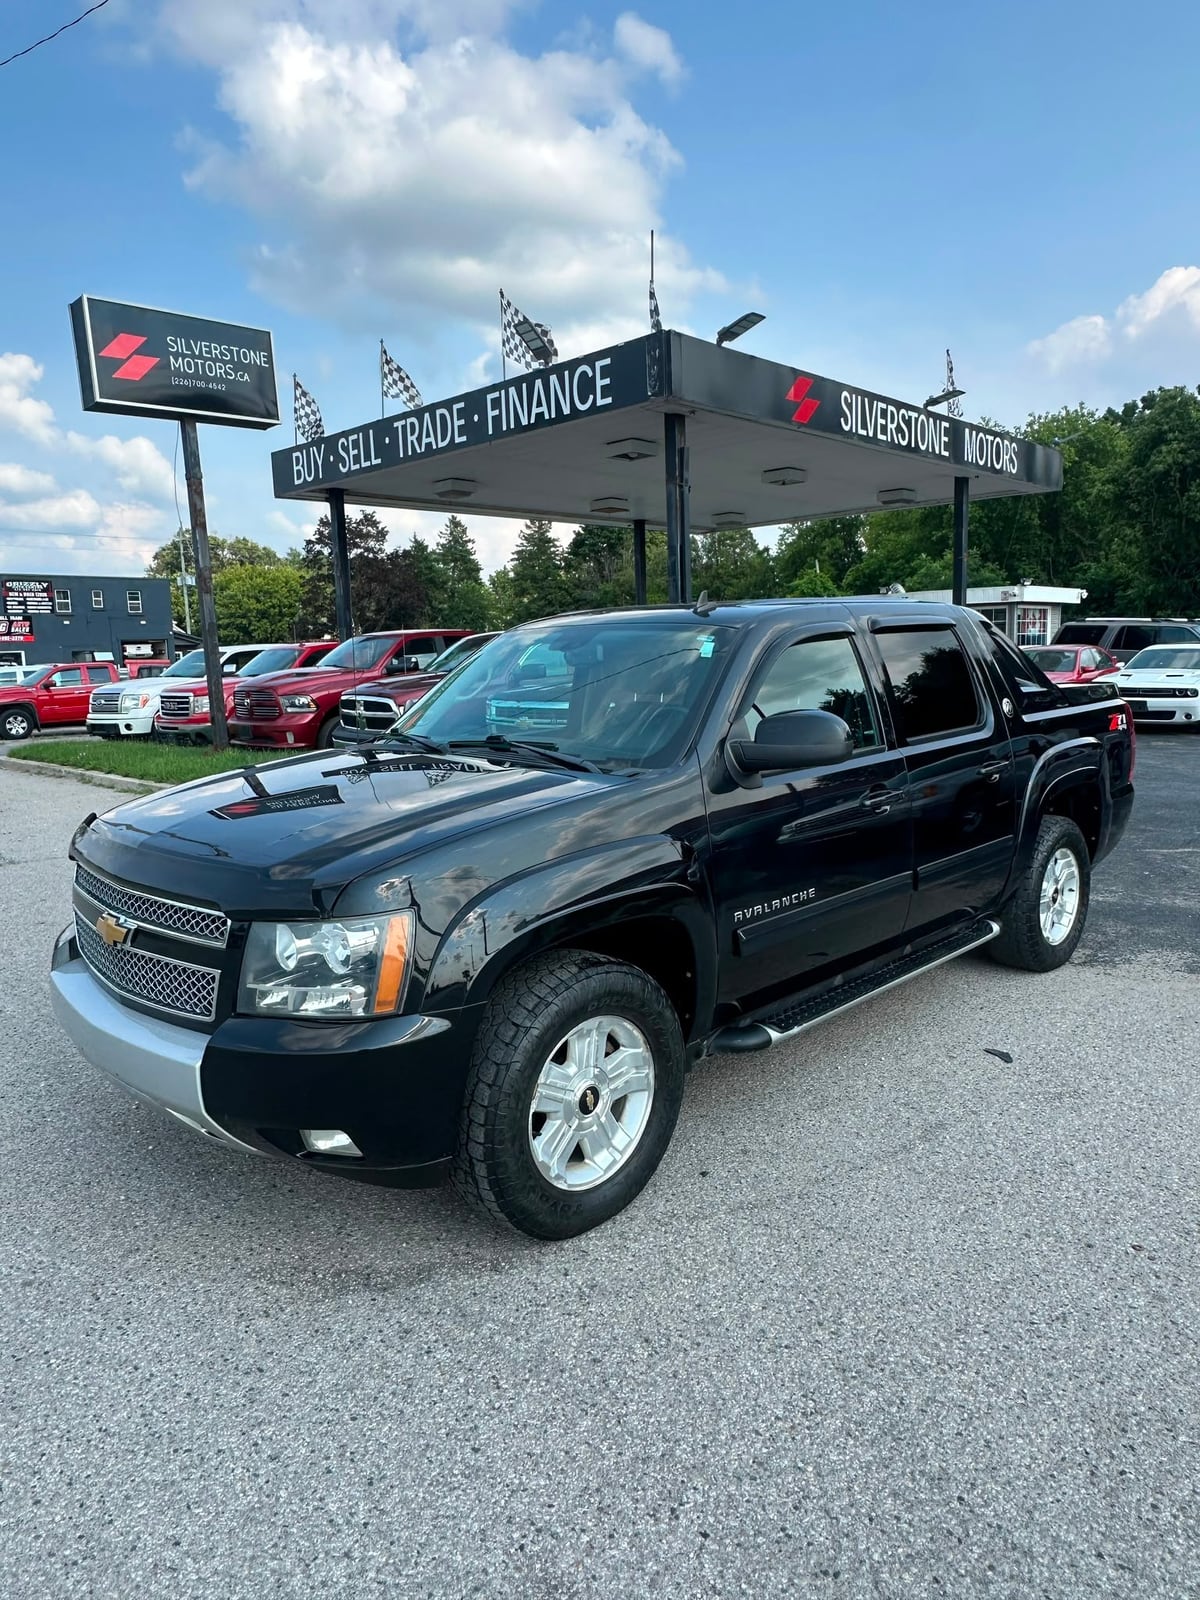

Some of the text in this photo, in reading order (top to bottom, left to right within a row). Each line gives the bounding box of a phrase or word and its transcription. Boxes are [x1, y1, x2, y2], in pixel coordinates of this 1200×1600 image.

[166, 336, 269, 367] SILVERSTONE
[169, 355, 250, 382] MOTORS.CA
[171, 376, 226, 391] (226)700-4542
[292, 357, 613, 485] BUY SELL TRADE FINANCE
[840, 390, 1018, 474] SILVERSTONE MOTORS
[1108, 713, 1126, 731] Z71
[734, 887, 816, 923] AVALANCHE
